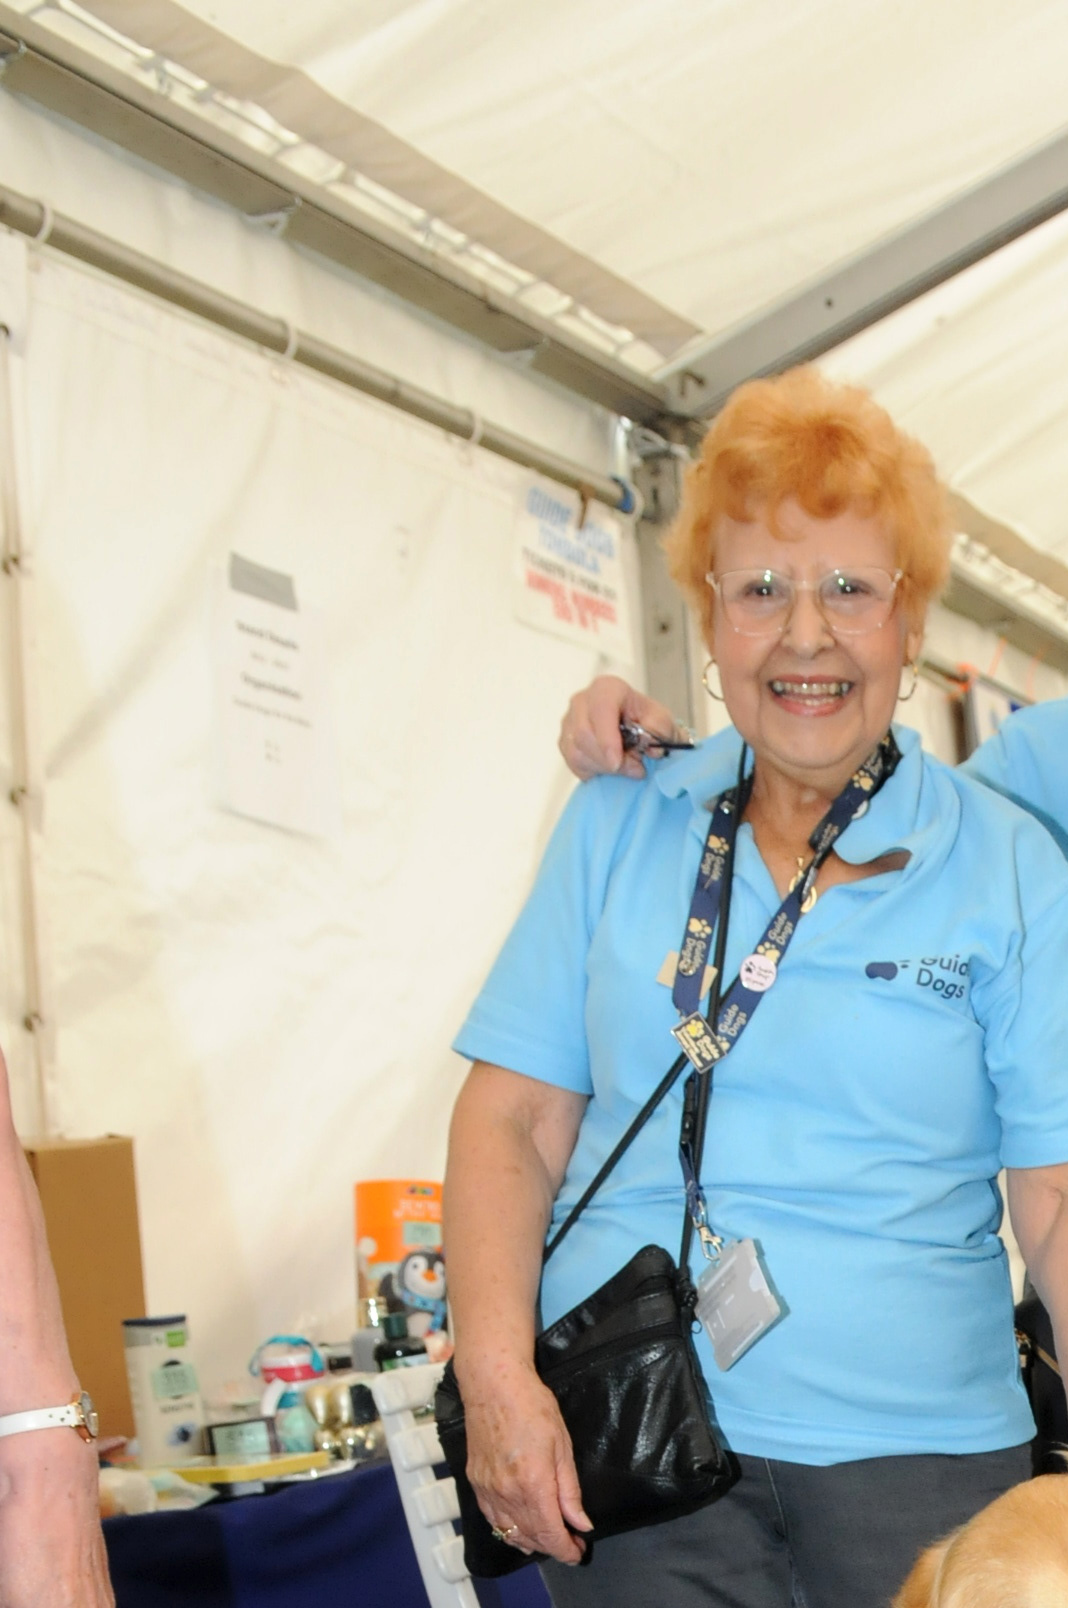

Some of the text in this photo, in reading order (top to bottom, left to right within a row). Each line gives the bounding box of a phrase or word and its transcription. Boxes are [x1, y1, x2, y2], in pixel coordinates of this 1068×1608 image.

[768, 912, 788, 941] Guide
[777, 920, 794, 947] Dogs
[915, 967, 966, 1000] Dogs
[718, 1004, 739, 1034] Guide
[728, 1011, 747, 1038] Dogs
